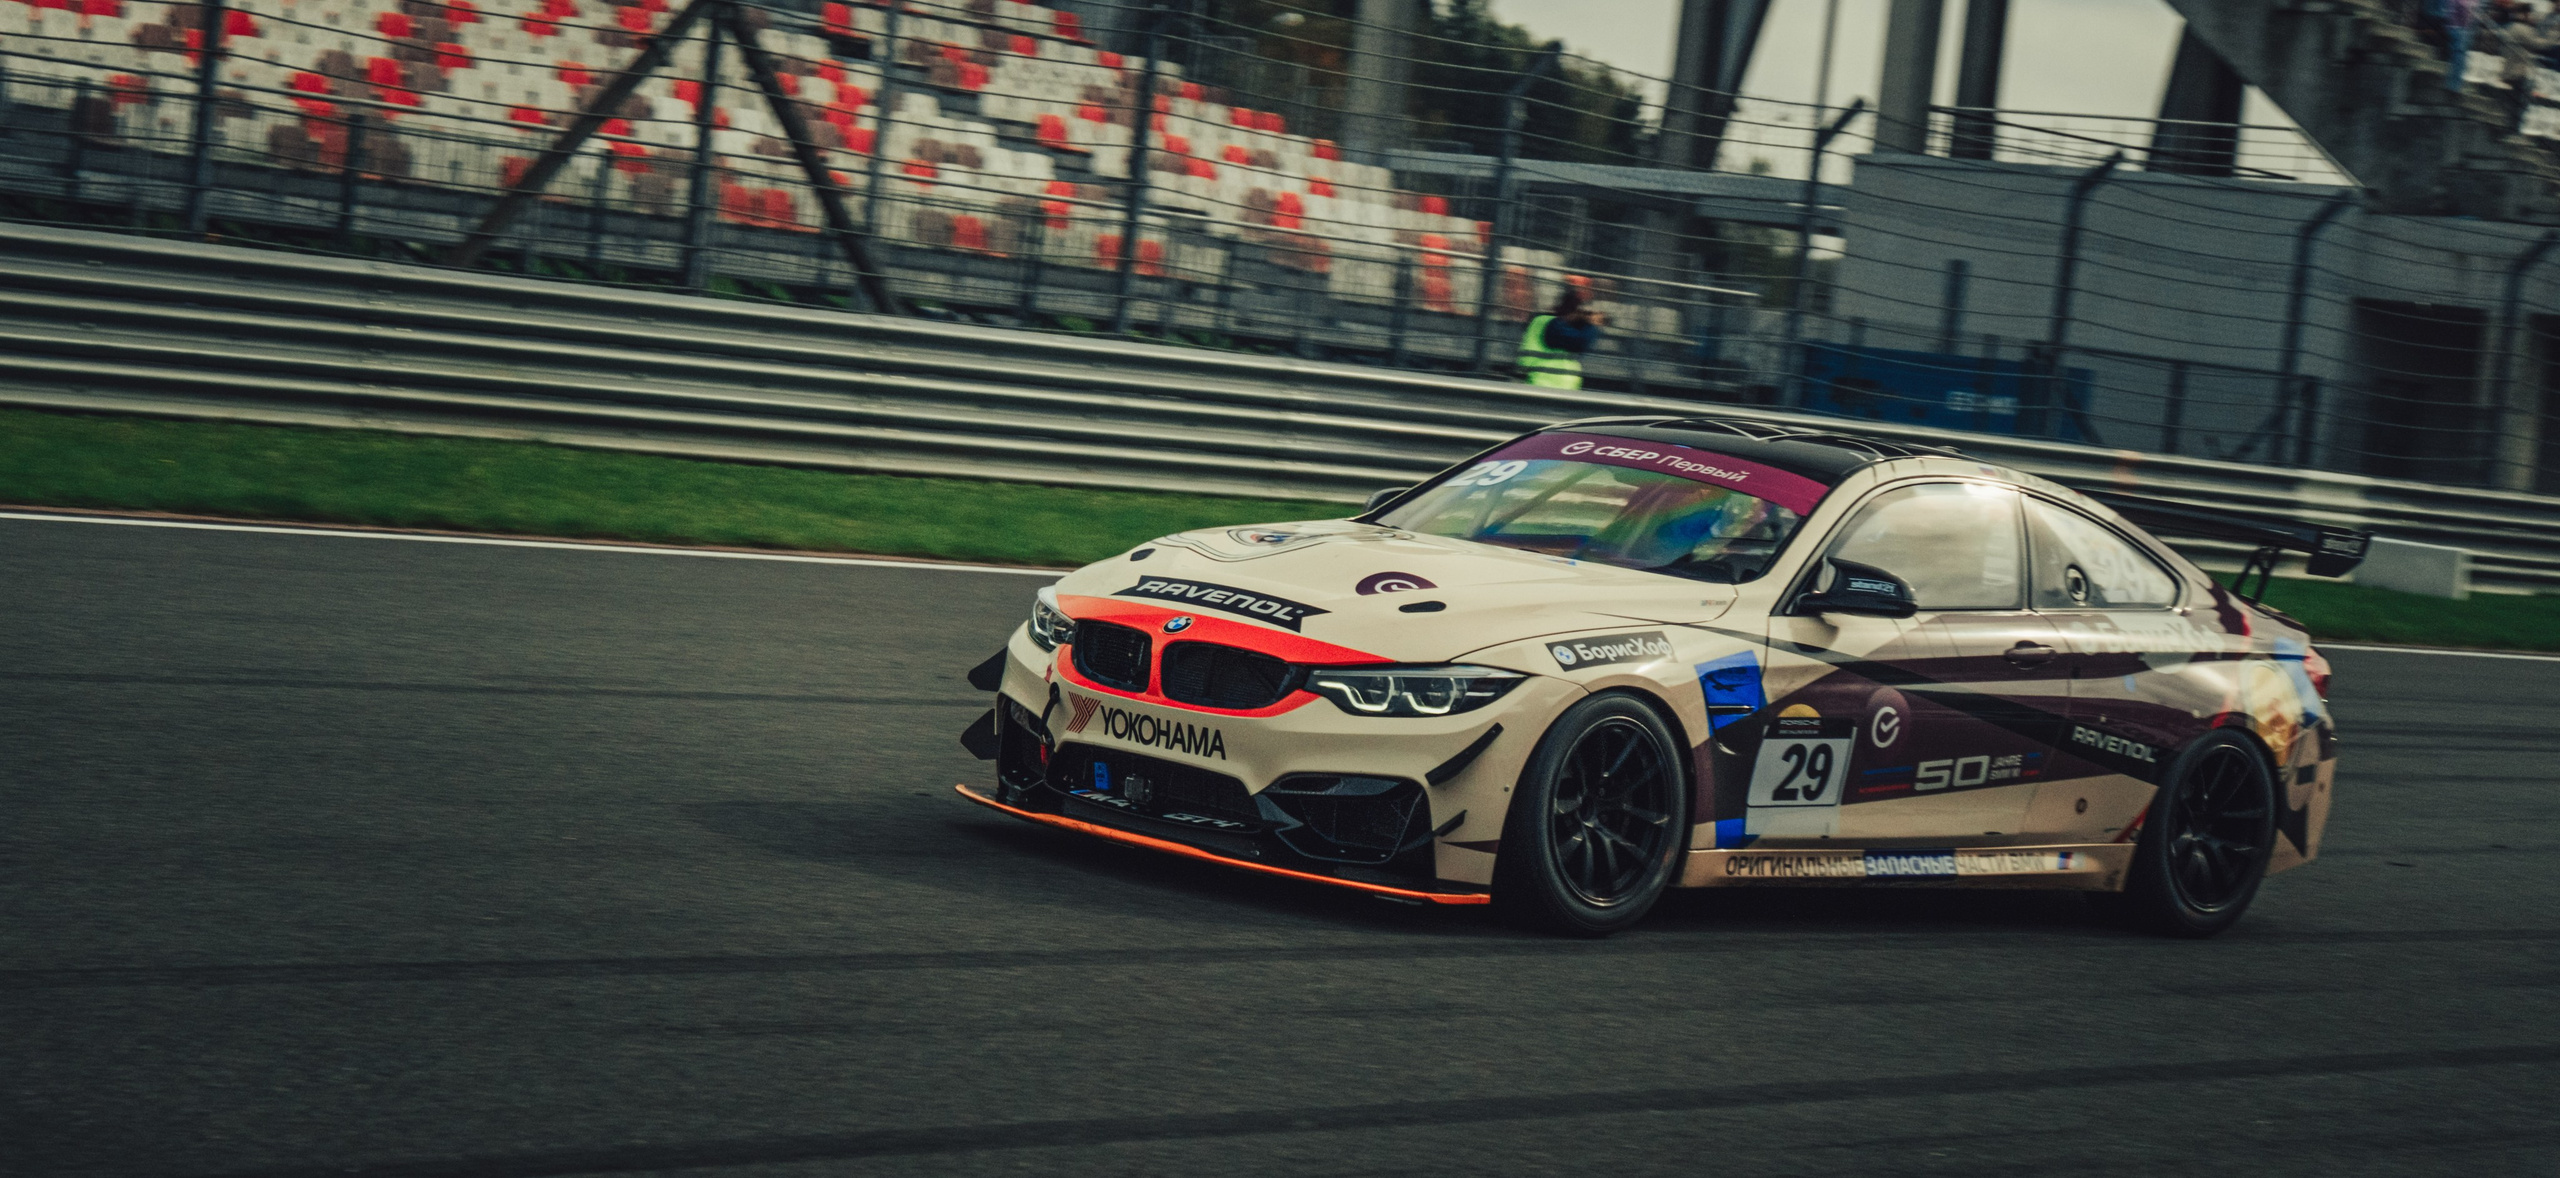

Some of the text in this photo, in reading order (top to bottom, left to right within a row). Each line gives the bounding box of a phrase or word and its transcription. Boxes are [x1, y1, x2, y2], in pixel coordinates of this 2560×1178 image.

[1442, 459, 1528, 487] 29
[1593, 445, 1751, 482] СБЕР Первый
[1135, 580, 1294, 622] RAVENOL
[1573, 637, 1674, 662] БорисХоф
[1100, 704, 1227, 761] YOKOHAMA
[2070, 724, 2159, 764] RAVENOL
[1771, 742, 1834, 802] 29
[1914, 754, 1991, 792] 50
[1725, 855, 1866, 877] ОРИГИНАЛЬНЫЕ
[1865, 855, 1957, 876] ЗАПАСНЫЕ
